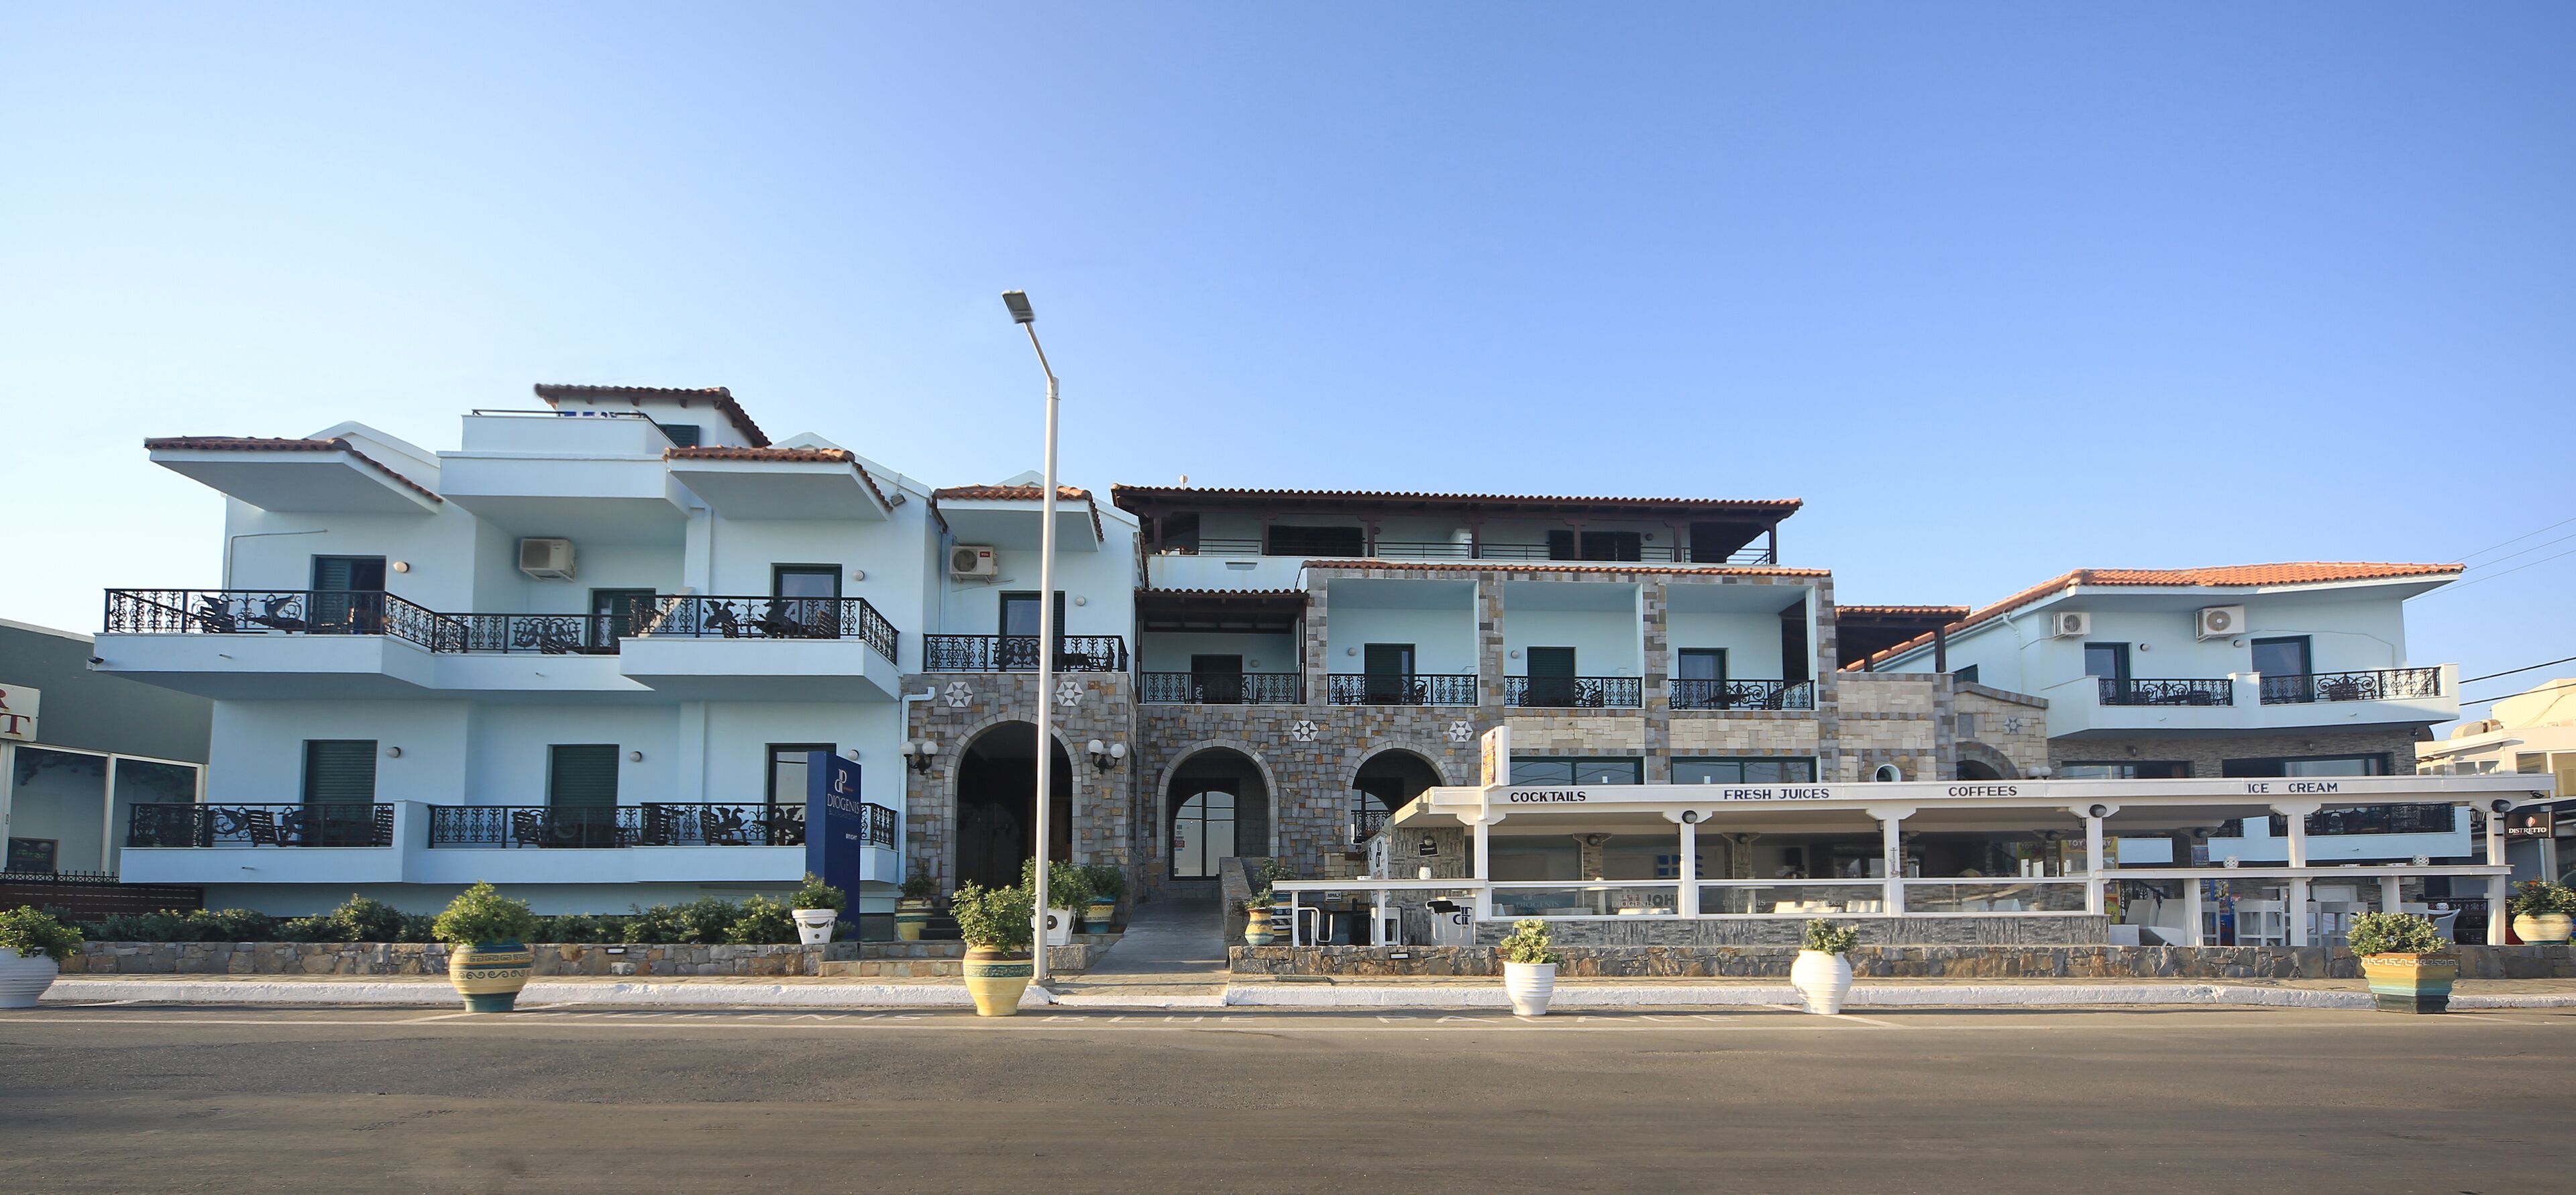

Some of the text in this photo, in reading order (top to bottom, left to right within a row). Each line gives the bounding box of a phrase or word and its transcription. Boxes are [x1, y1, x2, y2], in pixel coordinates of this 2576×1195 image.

[1949, 786, 2017, 796] COFFEES
[2248, 782, 2338, 793] ICE CREAM
[1511, 791, 1586, 802] COCKTAILS
[1724, 788, 1829, 800] FRESH JUICES
[827, 793, 859, 814] DIOGENIS
[1648, 894, 1678, 906] JOH
